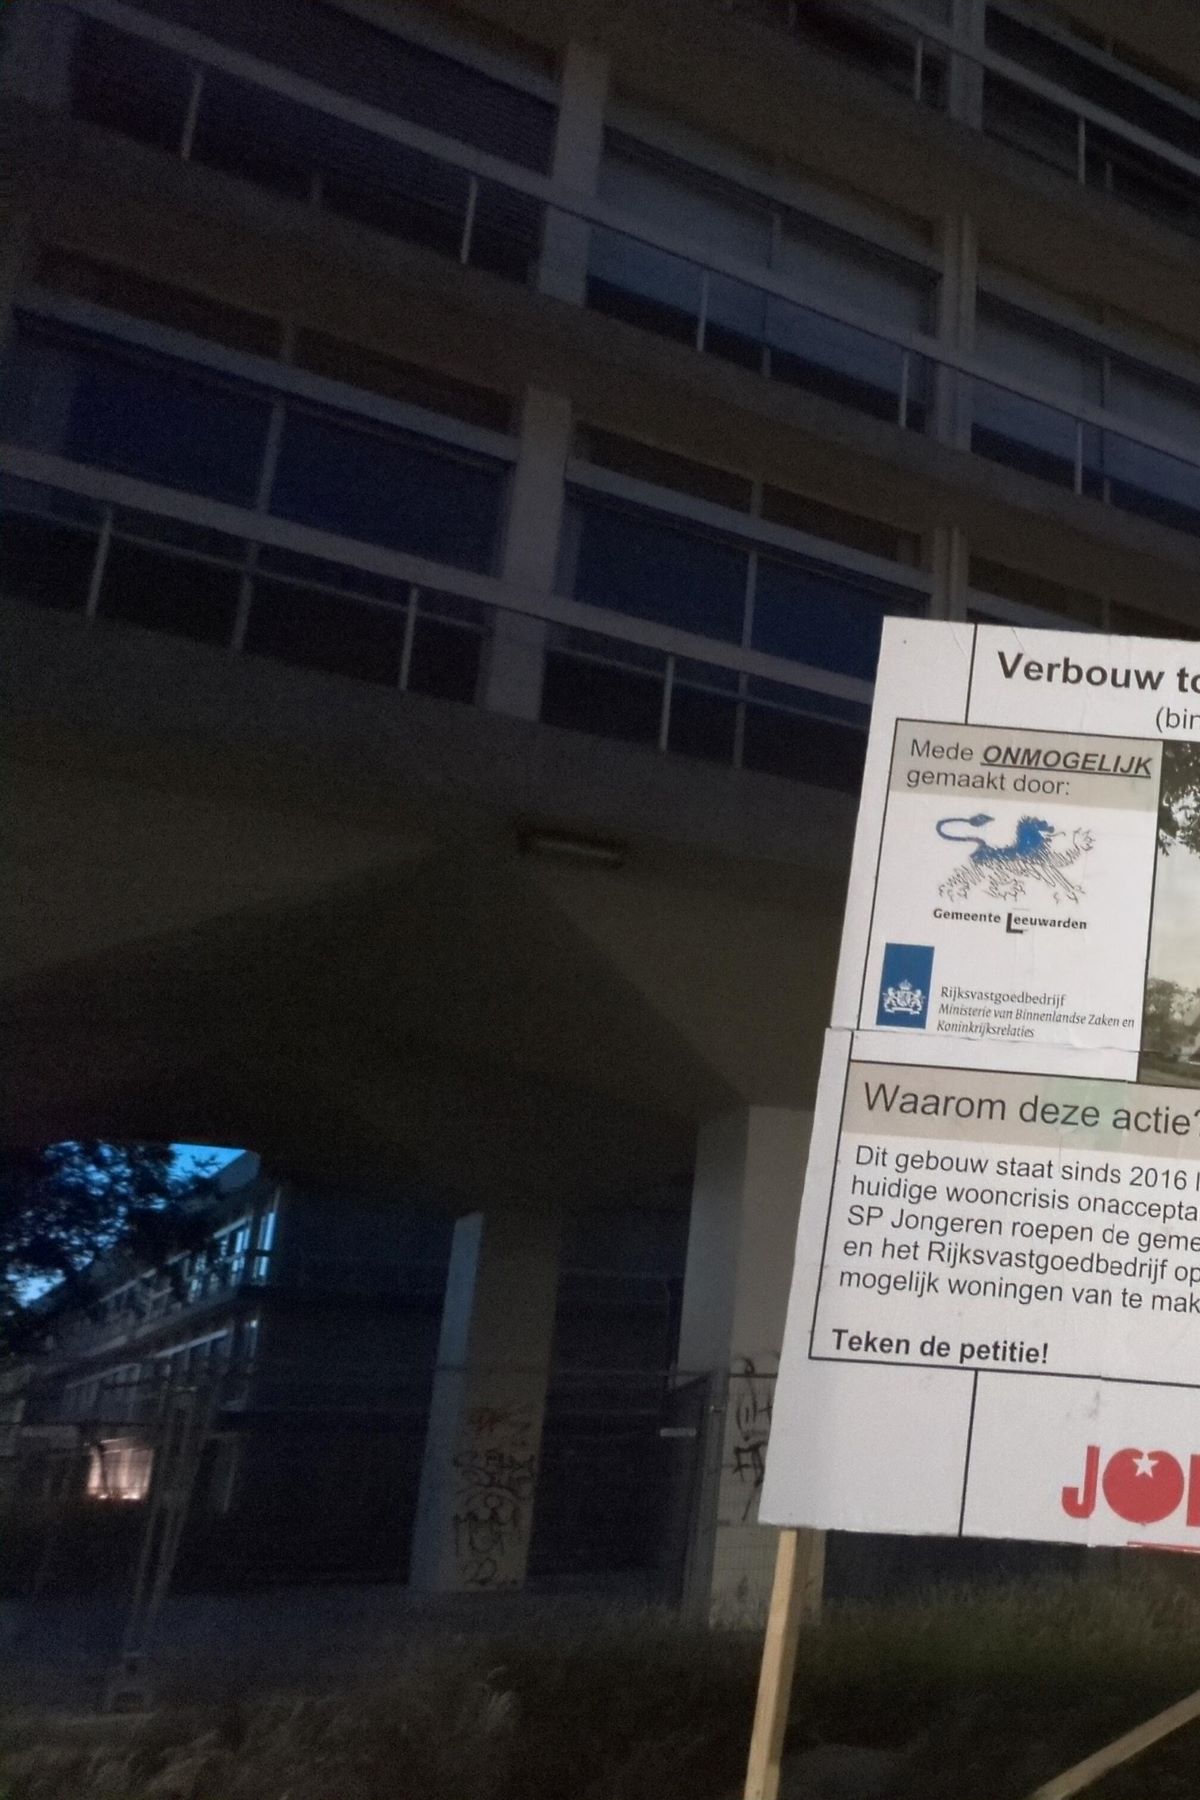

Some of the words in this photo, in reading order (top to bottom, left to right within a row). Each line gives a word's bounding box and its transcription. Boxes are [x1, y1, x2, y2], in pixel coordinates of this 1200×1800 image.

[997, 650, 1165, 691] Verbouw
[910, 738, 974, 762] Mede
[979, 744, 1153, 780] ONMOGELIJK
[906, 769, 1006, 792] gemaakt
[1013, 773, 1070, 796] door:
[932, 907, 1002, 924] Gemeente
[1005, 912, 1087, 935] Leeuwarden
[938, 1003, 992, 1018] Ministerie
[993, 1009, 1014, 1020] van
[1014, 1008, 1087, 1025] Binnenlandse
[1087, 1013, 1120, 1027] Zaken
[1121, 1018, 1135, 1028] en
[940, 985, 1066, 1010] Rijksvastgoedbedrijf
[936, 1019, 1035, 1038] Koninkrijksrelaties
[864, 1081, 1006, 1121] Waarom
[1018, 1094, 1100, 1128] deze
[855, 1144, 889, 1168] Dit
[894, 1149, 989, 1174] gebouw
[995, 1156, 1054, 1180] staat
[1060, 1160, 1121, 1185] sinds
[1129, 1166, 1187, 1191] 2016
[851, 1174, 938, 1205] huidige
[945, 1186, 1069, 1210] wooncrisis
[847, 1204, 884, 1227] SP
[890, 1208, 1003, 1237] Jongeren
[1011, 1221, 1093, 1245] roepen
[1101, 1223, 1130, 1246] de
[843, 1240, 873, 1258] en
[881, 1237, 920, 1261] het
[927, 1240, 1169, 1285] Rijksvastgoedbedrijf
[839, 1269, 939, 1298] mogelijk
[947, 1276, 1063, 1306] woningen
[1071, 1287, 1112, 1307] van
[1121, 1287, 1143, 1309] te
[831, 1328, 911, 1355] Teken
[919, 1335, 951, 1358] de
[959, 1339, 1049, 1365] petitie!
